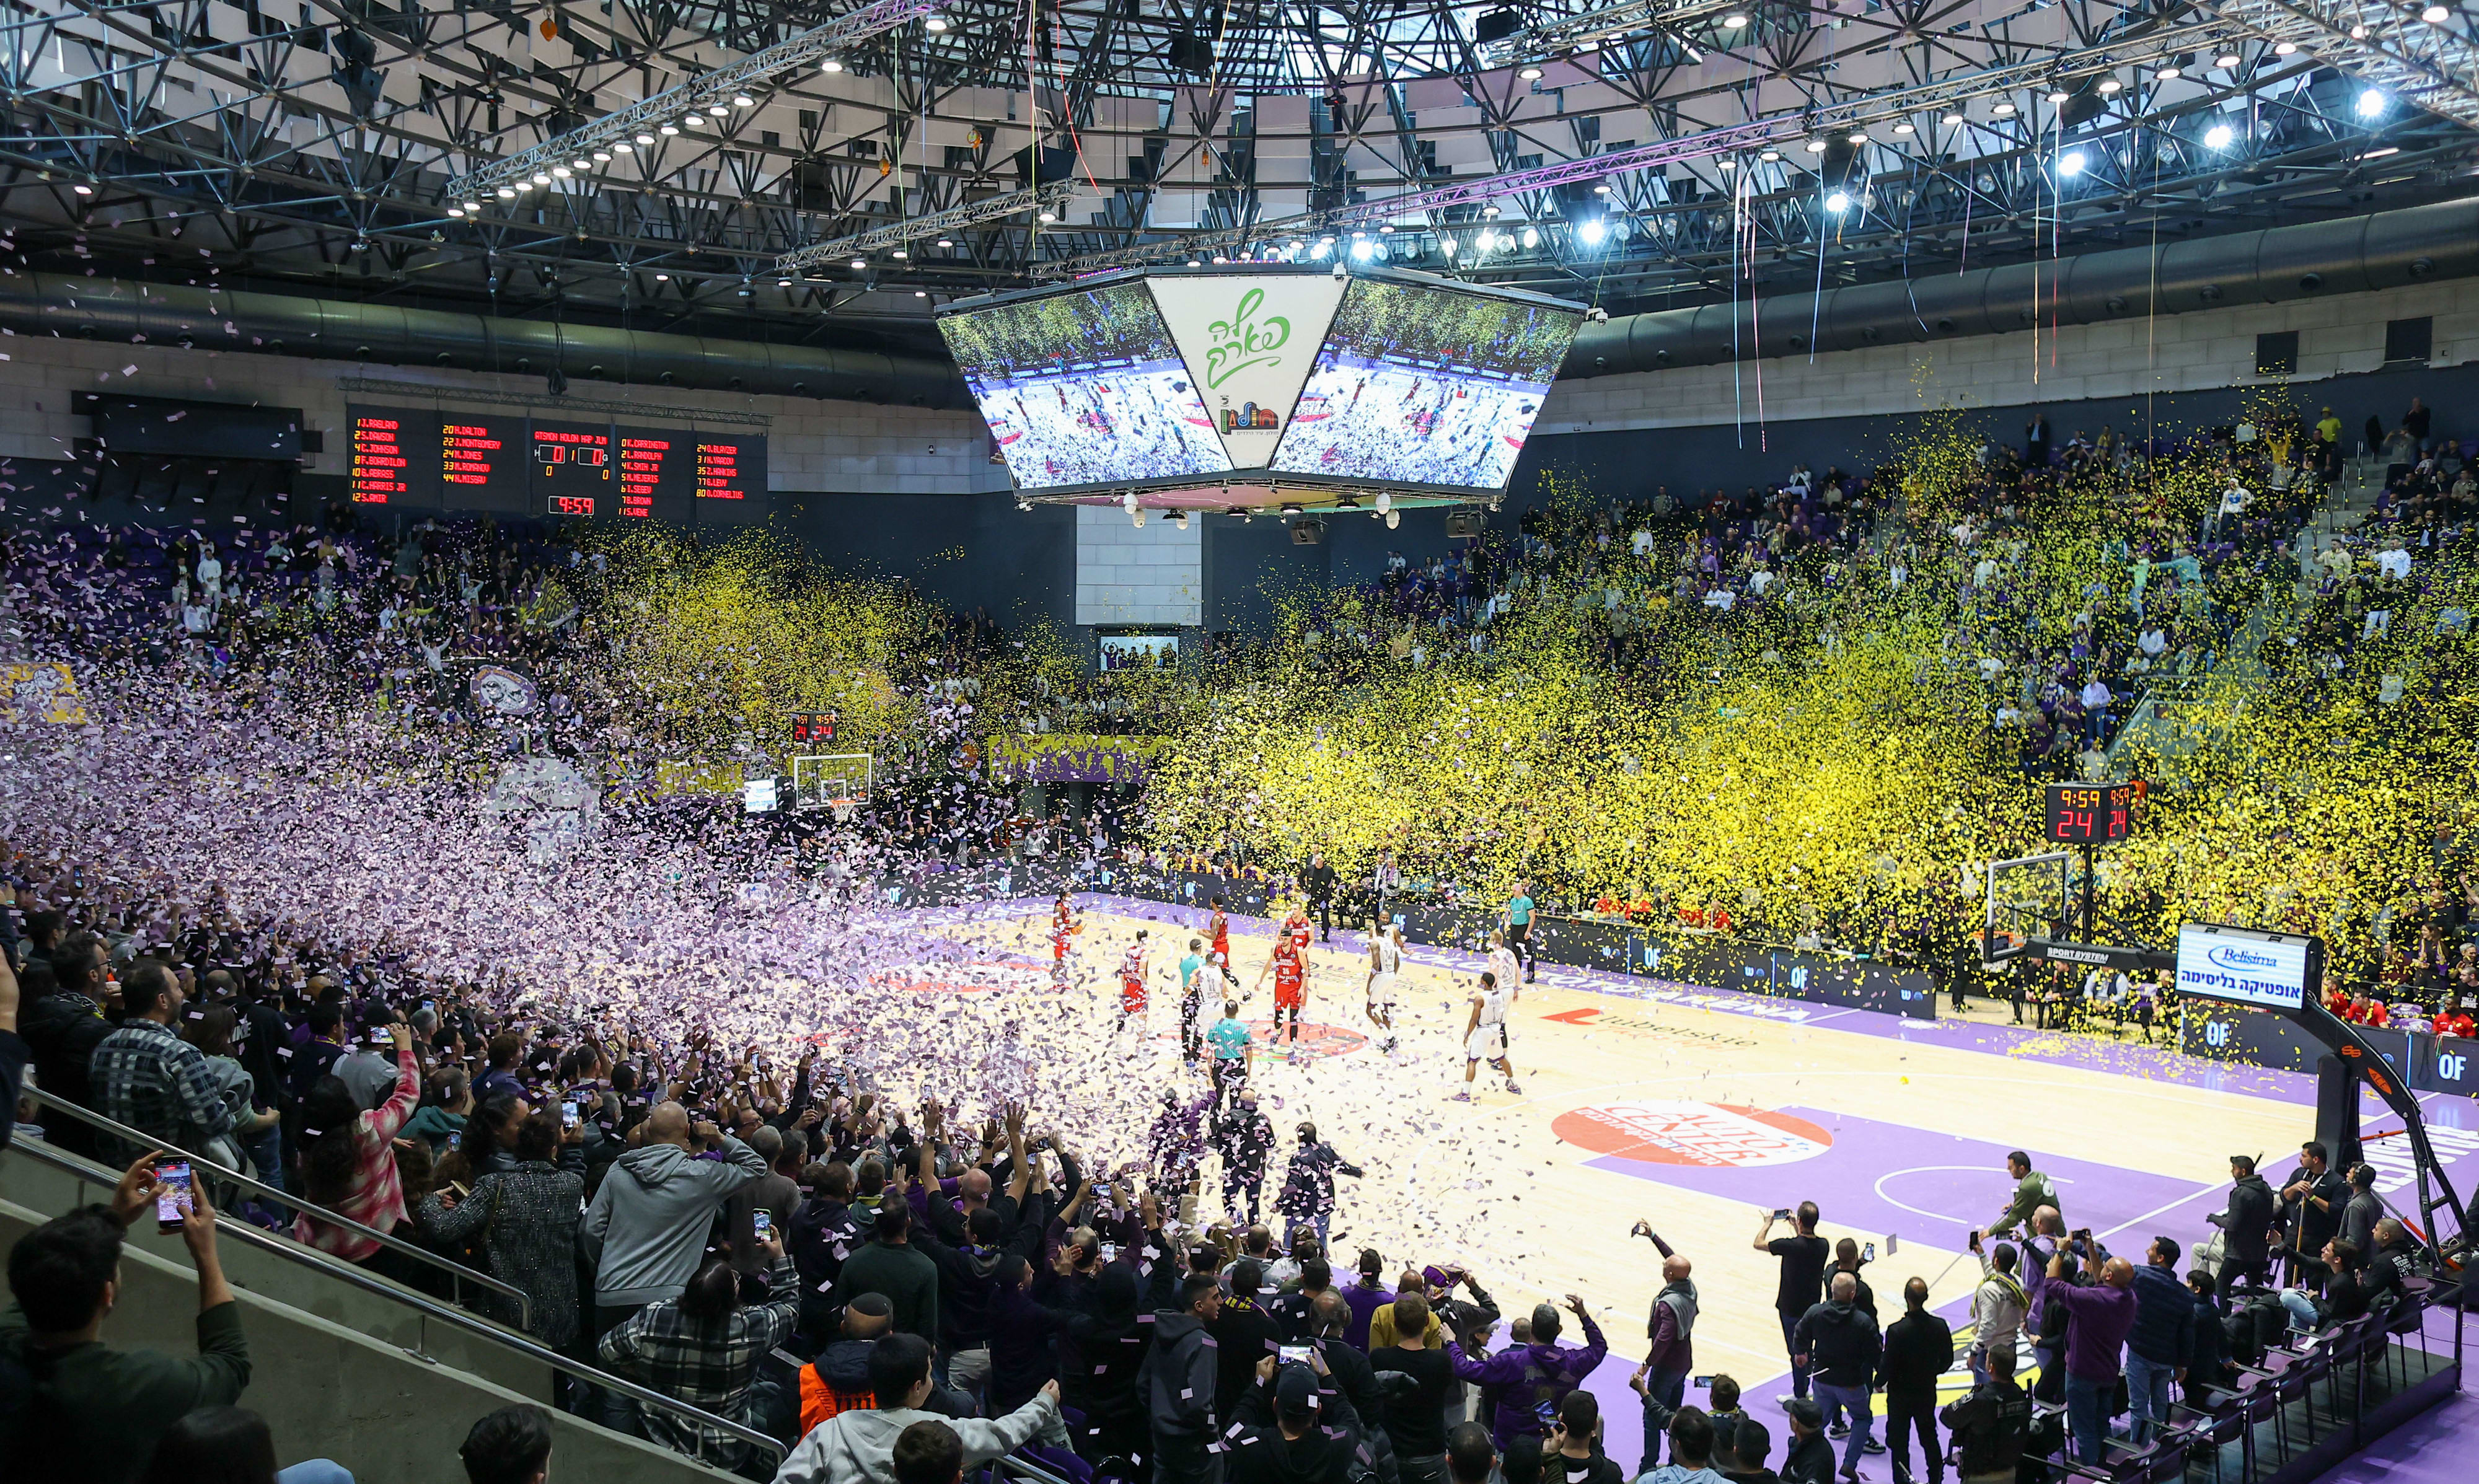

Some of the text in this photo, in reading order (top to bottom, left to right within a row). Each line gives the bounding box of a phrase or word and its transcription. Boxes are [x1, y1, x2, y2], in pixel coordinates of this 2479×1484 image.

[1207, 316, 1290, 389] פארק
[358, 418, 361, 427] 1
[443, 425, 454, 434] 20
[354, 430, 361, 440] 2
[534, 431, 608, 445] ATSMON HOLON HAP JLM
[443, 437, 454, 446] 22
[621, 439, 627, 447] 0
[354, 443, 361, 452] 4
[697, 444, 707, 452] 24
[443, 449, 454, 458] 24
[534, 449, 540, 457] H
[553, 446, 564, 462] 0
[592, 449, 603, 465] 0
[621, 450, 627, 459] 2
[354, 455, 361, 465] 8
[697, 455, 707, 463] 31
[443, 461, 454, 470] 33
[546, 465, 553, 476] 0
[621, 462, 627, 470] 4
[650, 463, 659, 472] JR
[352, 468, 361, 477] 10
[602, 469, 609, 480] 0
[697, 467, 706, 475] 35
[443, 474, 454, 482] 44
[621, 473, 626, 481] 5
[697, 478, 706, 486] 77
[397, 482, 407, 492] JR
[621, 485, 626, 493] 6
[353, 493, 361, 502] 12
[697, 489, 706, 497] 80
[622, 496, 626, 504] 7
[559, 497, 593, 514] 9:59
[619, 507, 626, 516] 11
[795, 725, 808, 740] 24
[814, 726, 833, 740] 24
[2061, 789, 2100, 808] 9:59
[2110, 788, 2129, 806] 9:59
[2057, 810, 2093, 837] 24
[2108, 810, 2127, 837] 24
[1644, 947, 1660, 968] OF
[2222, 947, 2277, 967] Belisima
[1502, 963, 1513, 978] 20
[1790, 967, 1808, 989] OF
[2182, 970, 2300, 999] אופטיקה בליסימה
[2206, 1021, 2230, 1047] OF
[2438, 1053, 2467, 1081] OF
[1604, 1107, 1768, 1159] CENTER
[1665, 1113, 1789, 1149] AUTO
